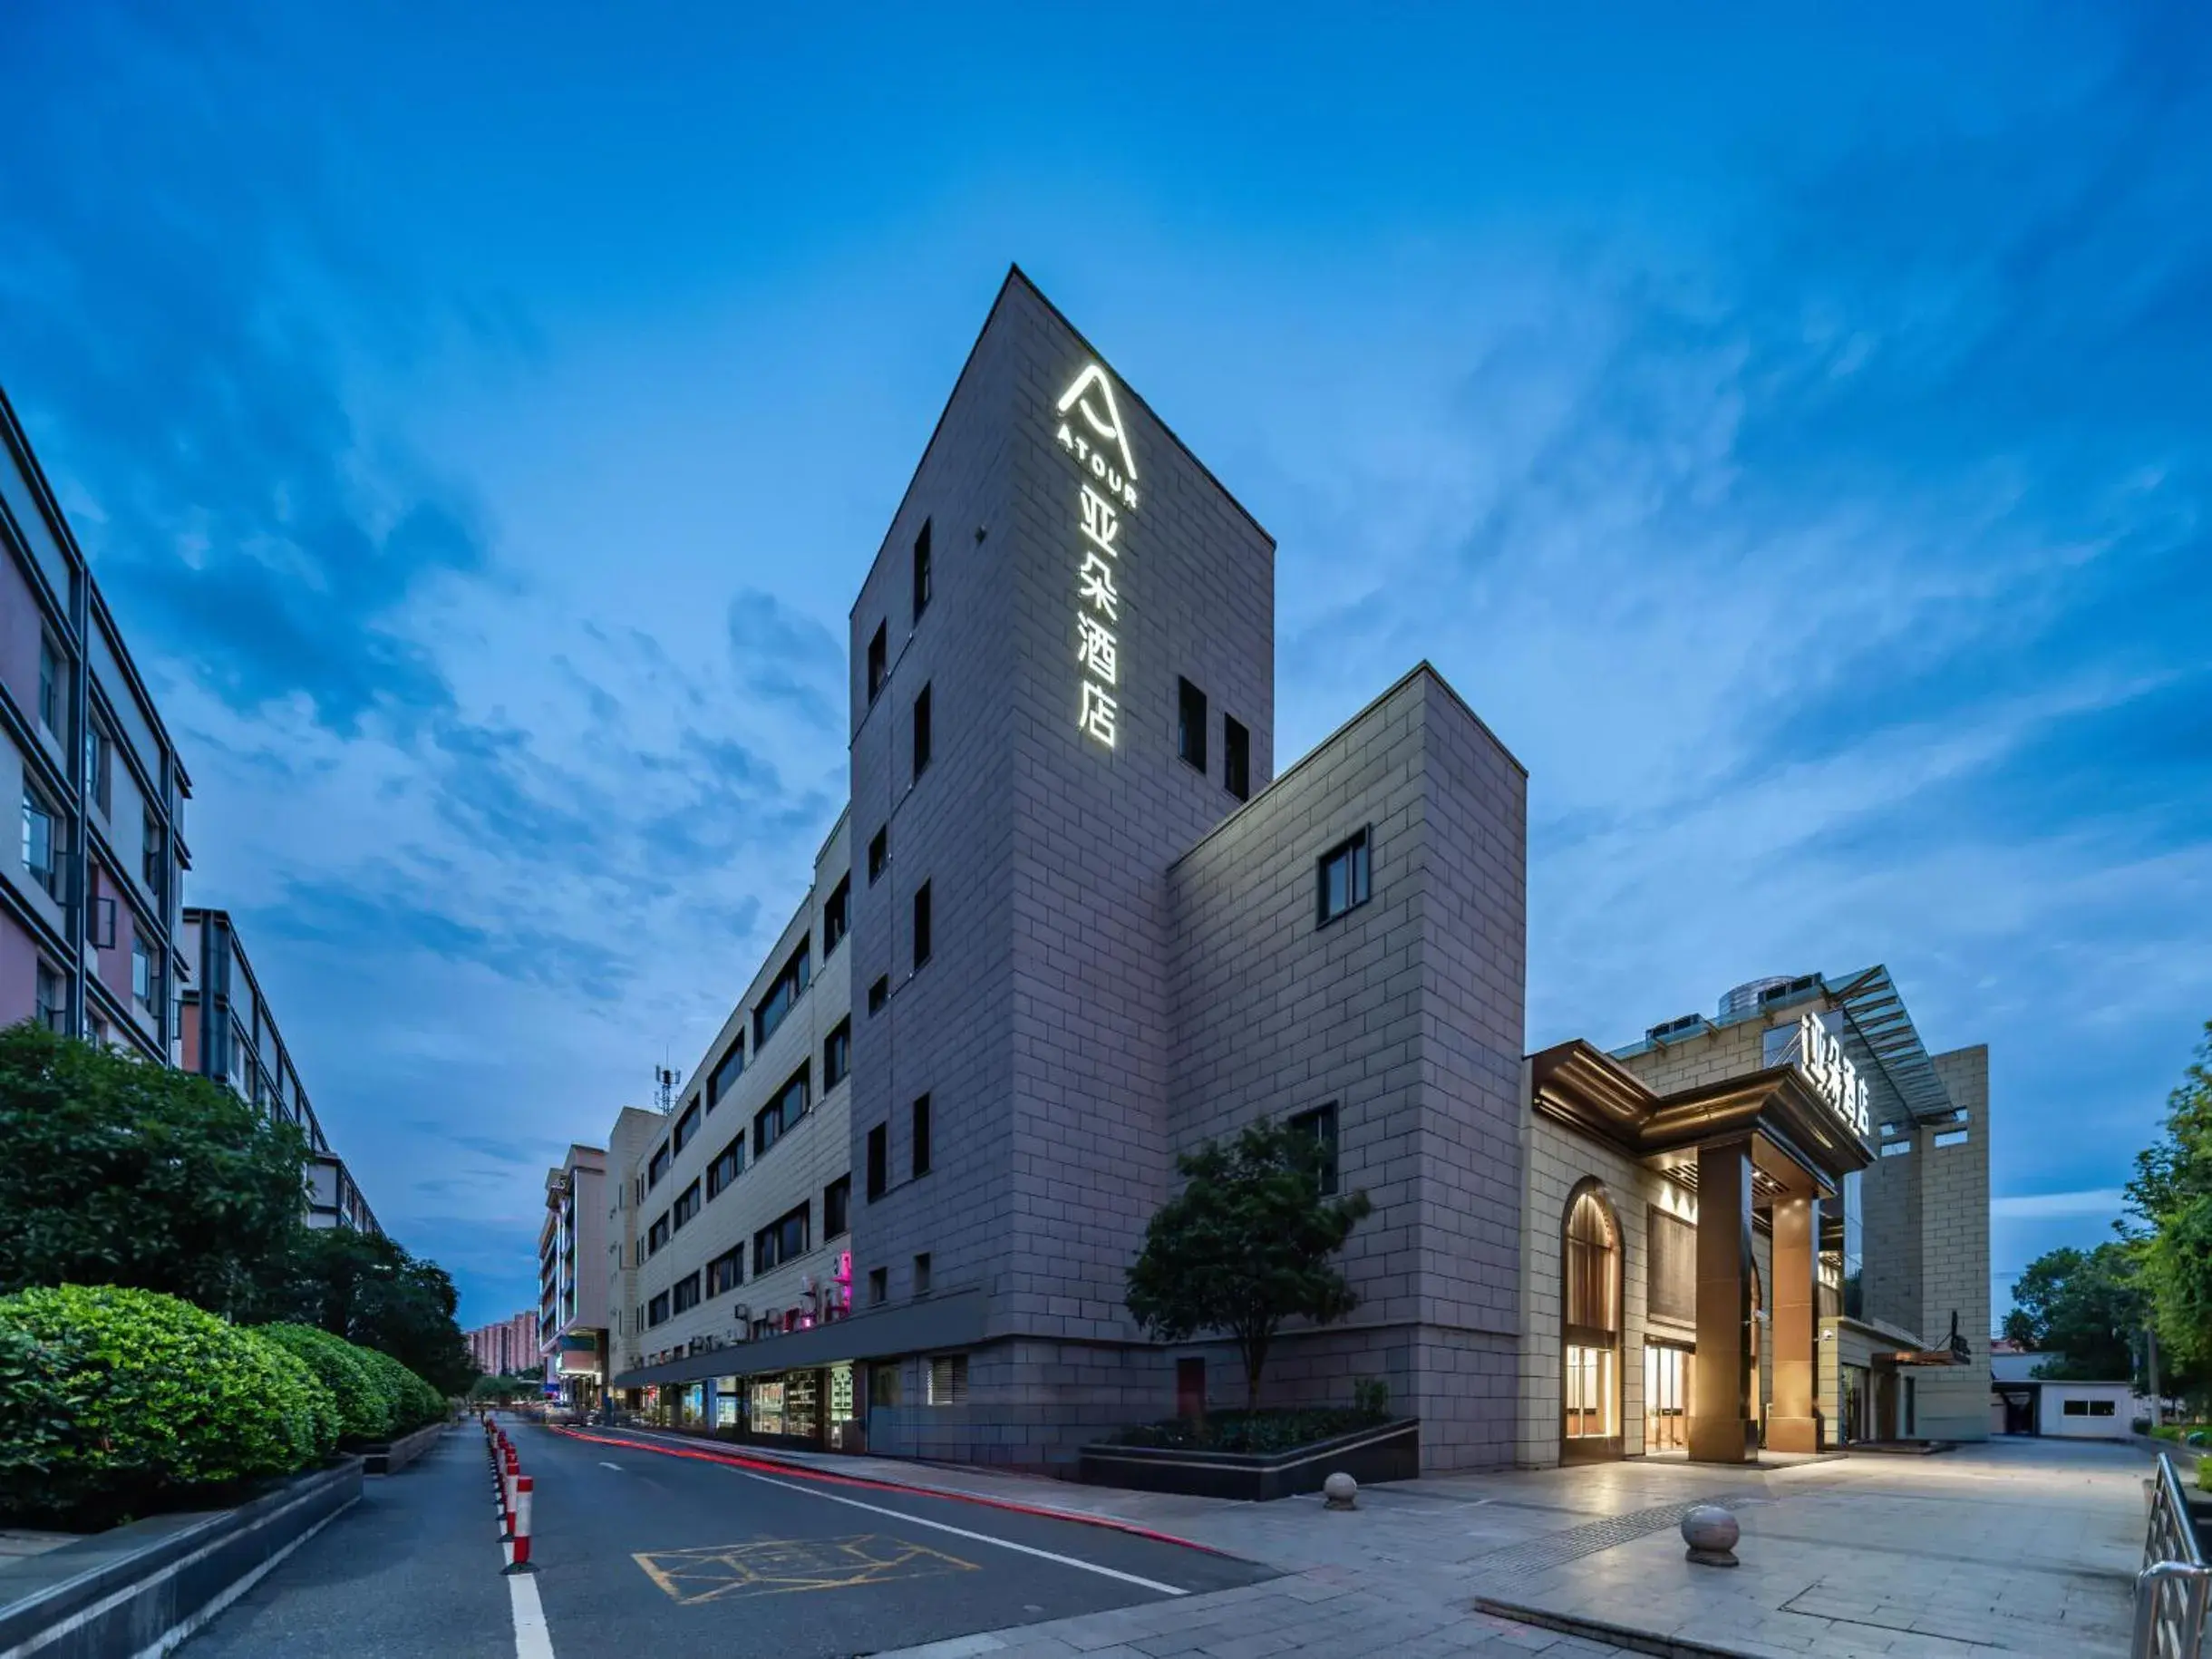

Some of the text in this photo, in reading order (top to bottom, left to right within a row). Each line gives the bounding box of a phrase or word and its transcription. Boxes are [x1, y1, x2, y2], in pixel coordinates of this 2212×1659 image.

[1057, 423, 1138, 508] ATOUR
[1077, 484, 1118, 748] 亚朵酒店
